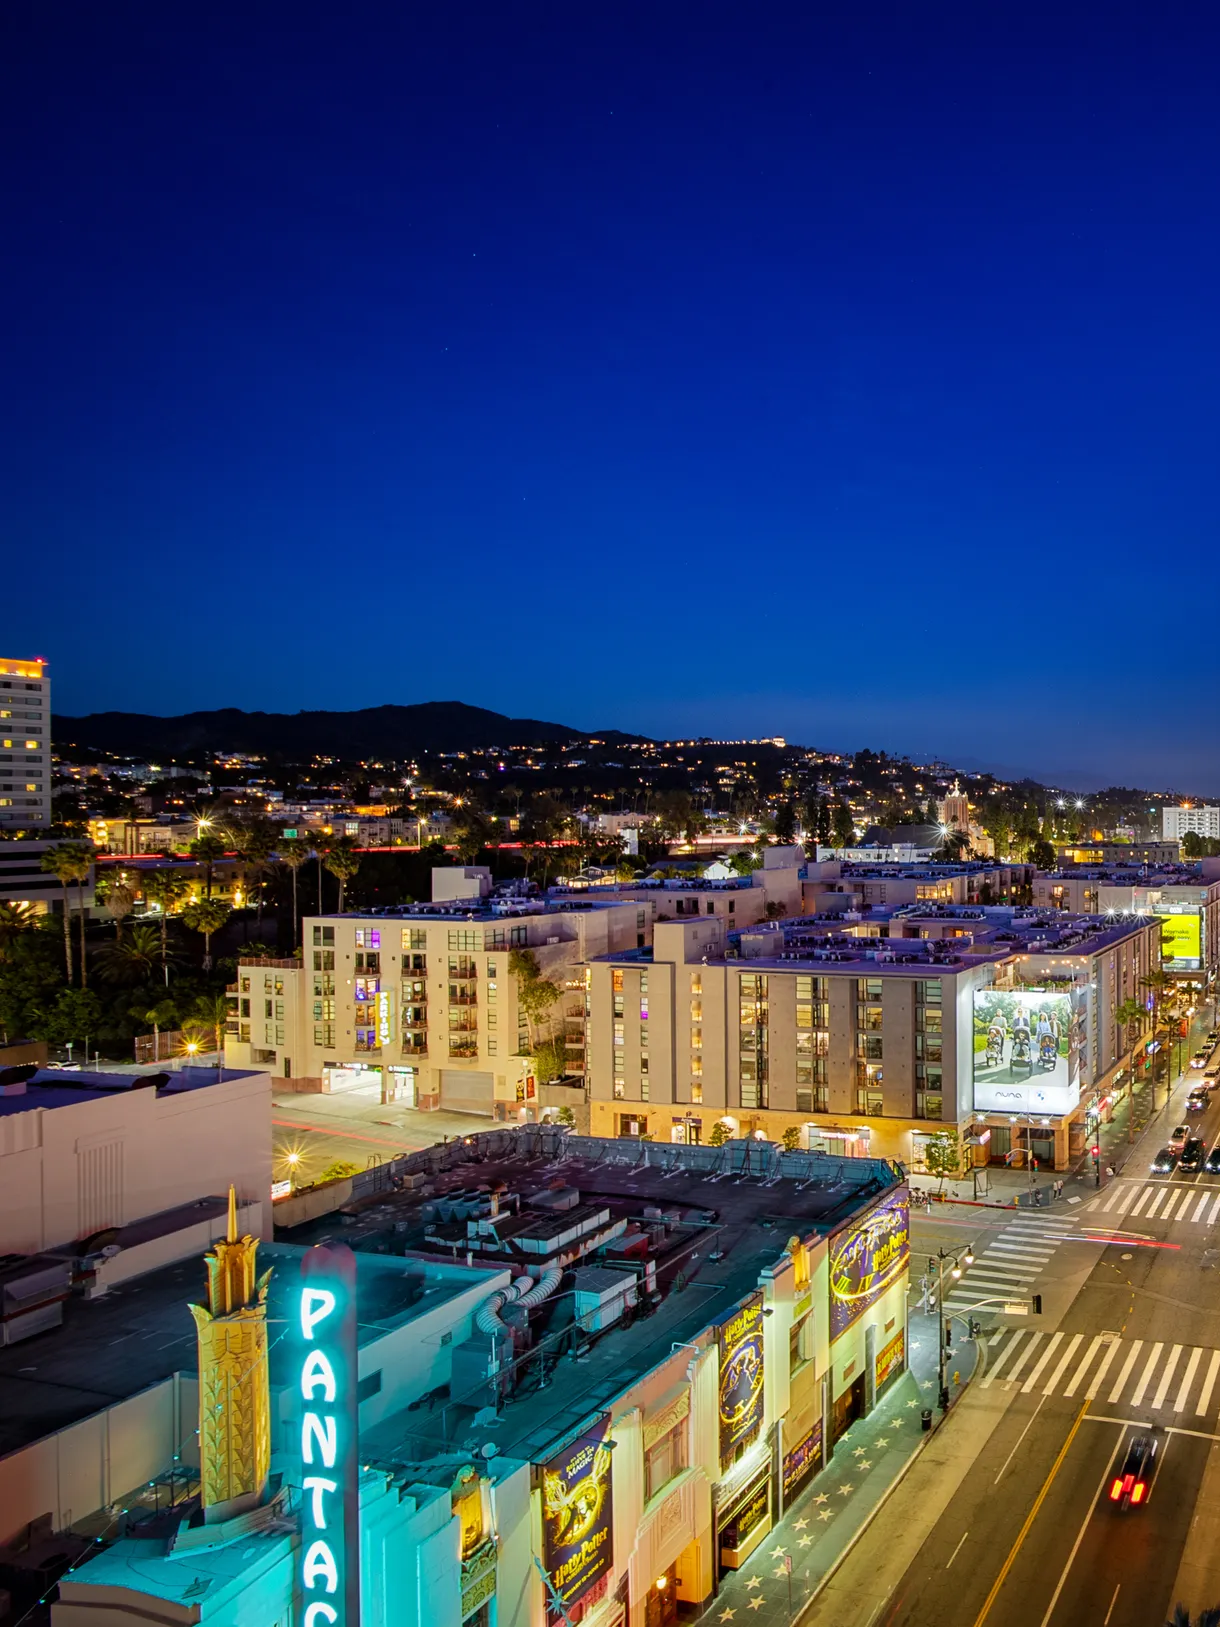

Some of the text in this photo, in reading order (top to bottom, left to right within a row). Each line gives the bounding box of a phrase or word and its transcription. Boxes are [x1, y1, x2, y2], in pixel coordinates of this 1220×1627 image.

[380, 992, 388, 1036] PARKING
[724, 1318, 744, 1343] Harry
[743, 1303, 761, 1331] Potter
[568, 1454, 593, 1479] MAGIC
[553, 1527, 608, 1589] Harry Potter
